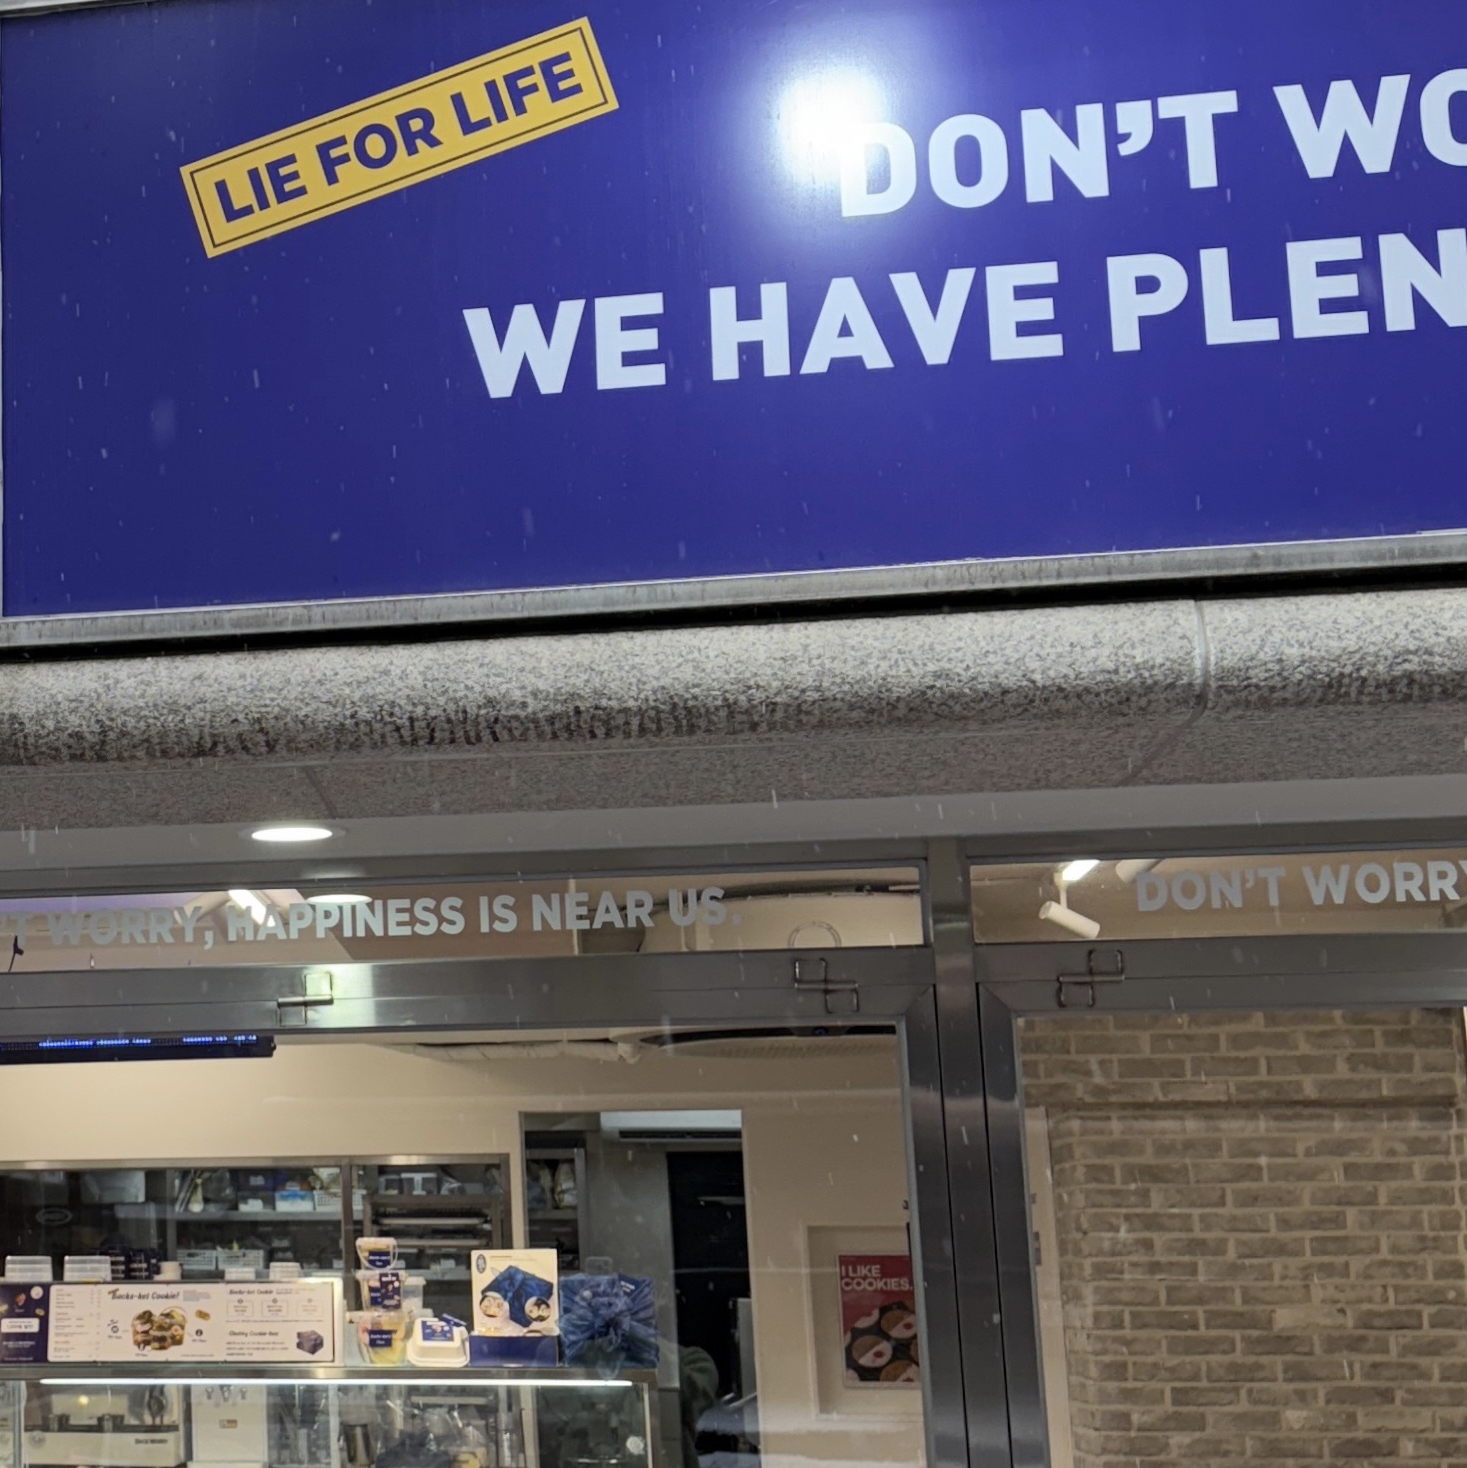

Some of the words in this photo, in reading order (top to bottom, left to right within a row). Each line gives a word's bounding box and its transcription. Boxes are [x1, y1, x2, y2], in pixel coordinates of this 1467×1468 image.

[214, 153, 306, 223] LIE
[316, 107, 438, 186] FOR
[451, 52, 582, 136] LIFE
[839, 91, 1237, 217] DON'T
[463, 292, 666, 399] WE
[709, 261, 1063, 381] HAVE
[1106, 228, 1467, 353] PLEN
[47, 906, 215, 948] WORRY,
[228, 896, 465, 940] HAPPINESS
[480, 896, 517, 933] IS
[533, 890, 655, 932] NEAR
[669, 887, 742, 926] US.
[1137, 867, 1285, 911] DON'T
[841, 1265, 846, 1277] I
[848, 1265, 881, 1277] LIKE
[842, 1277, 913, 1291] COOKIES.
